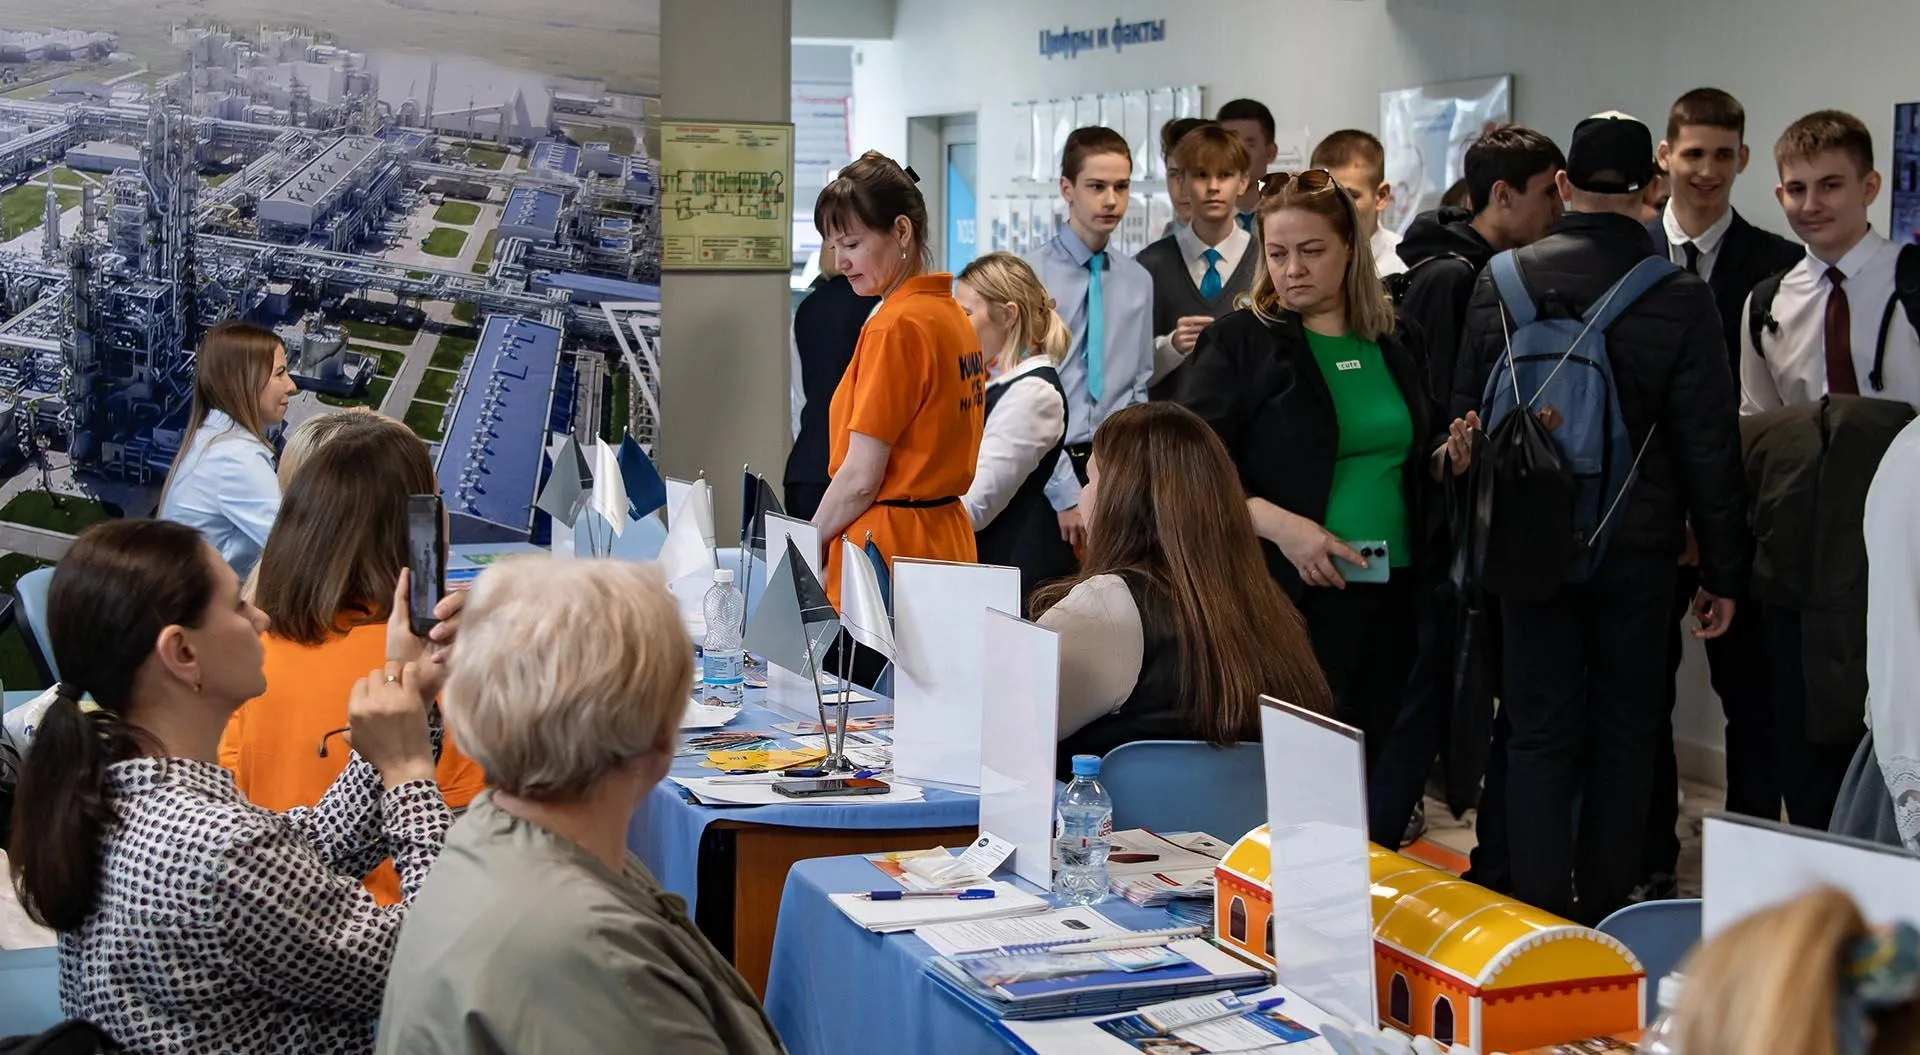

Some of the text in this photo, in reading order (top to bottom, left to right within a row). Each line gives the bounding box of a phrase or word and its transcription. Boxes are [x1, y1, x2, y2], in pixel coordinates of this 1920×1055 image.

[1039, 18, 1166, 58] Цифры и факты
